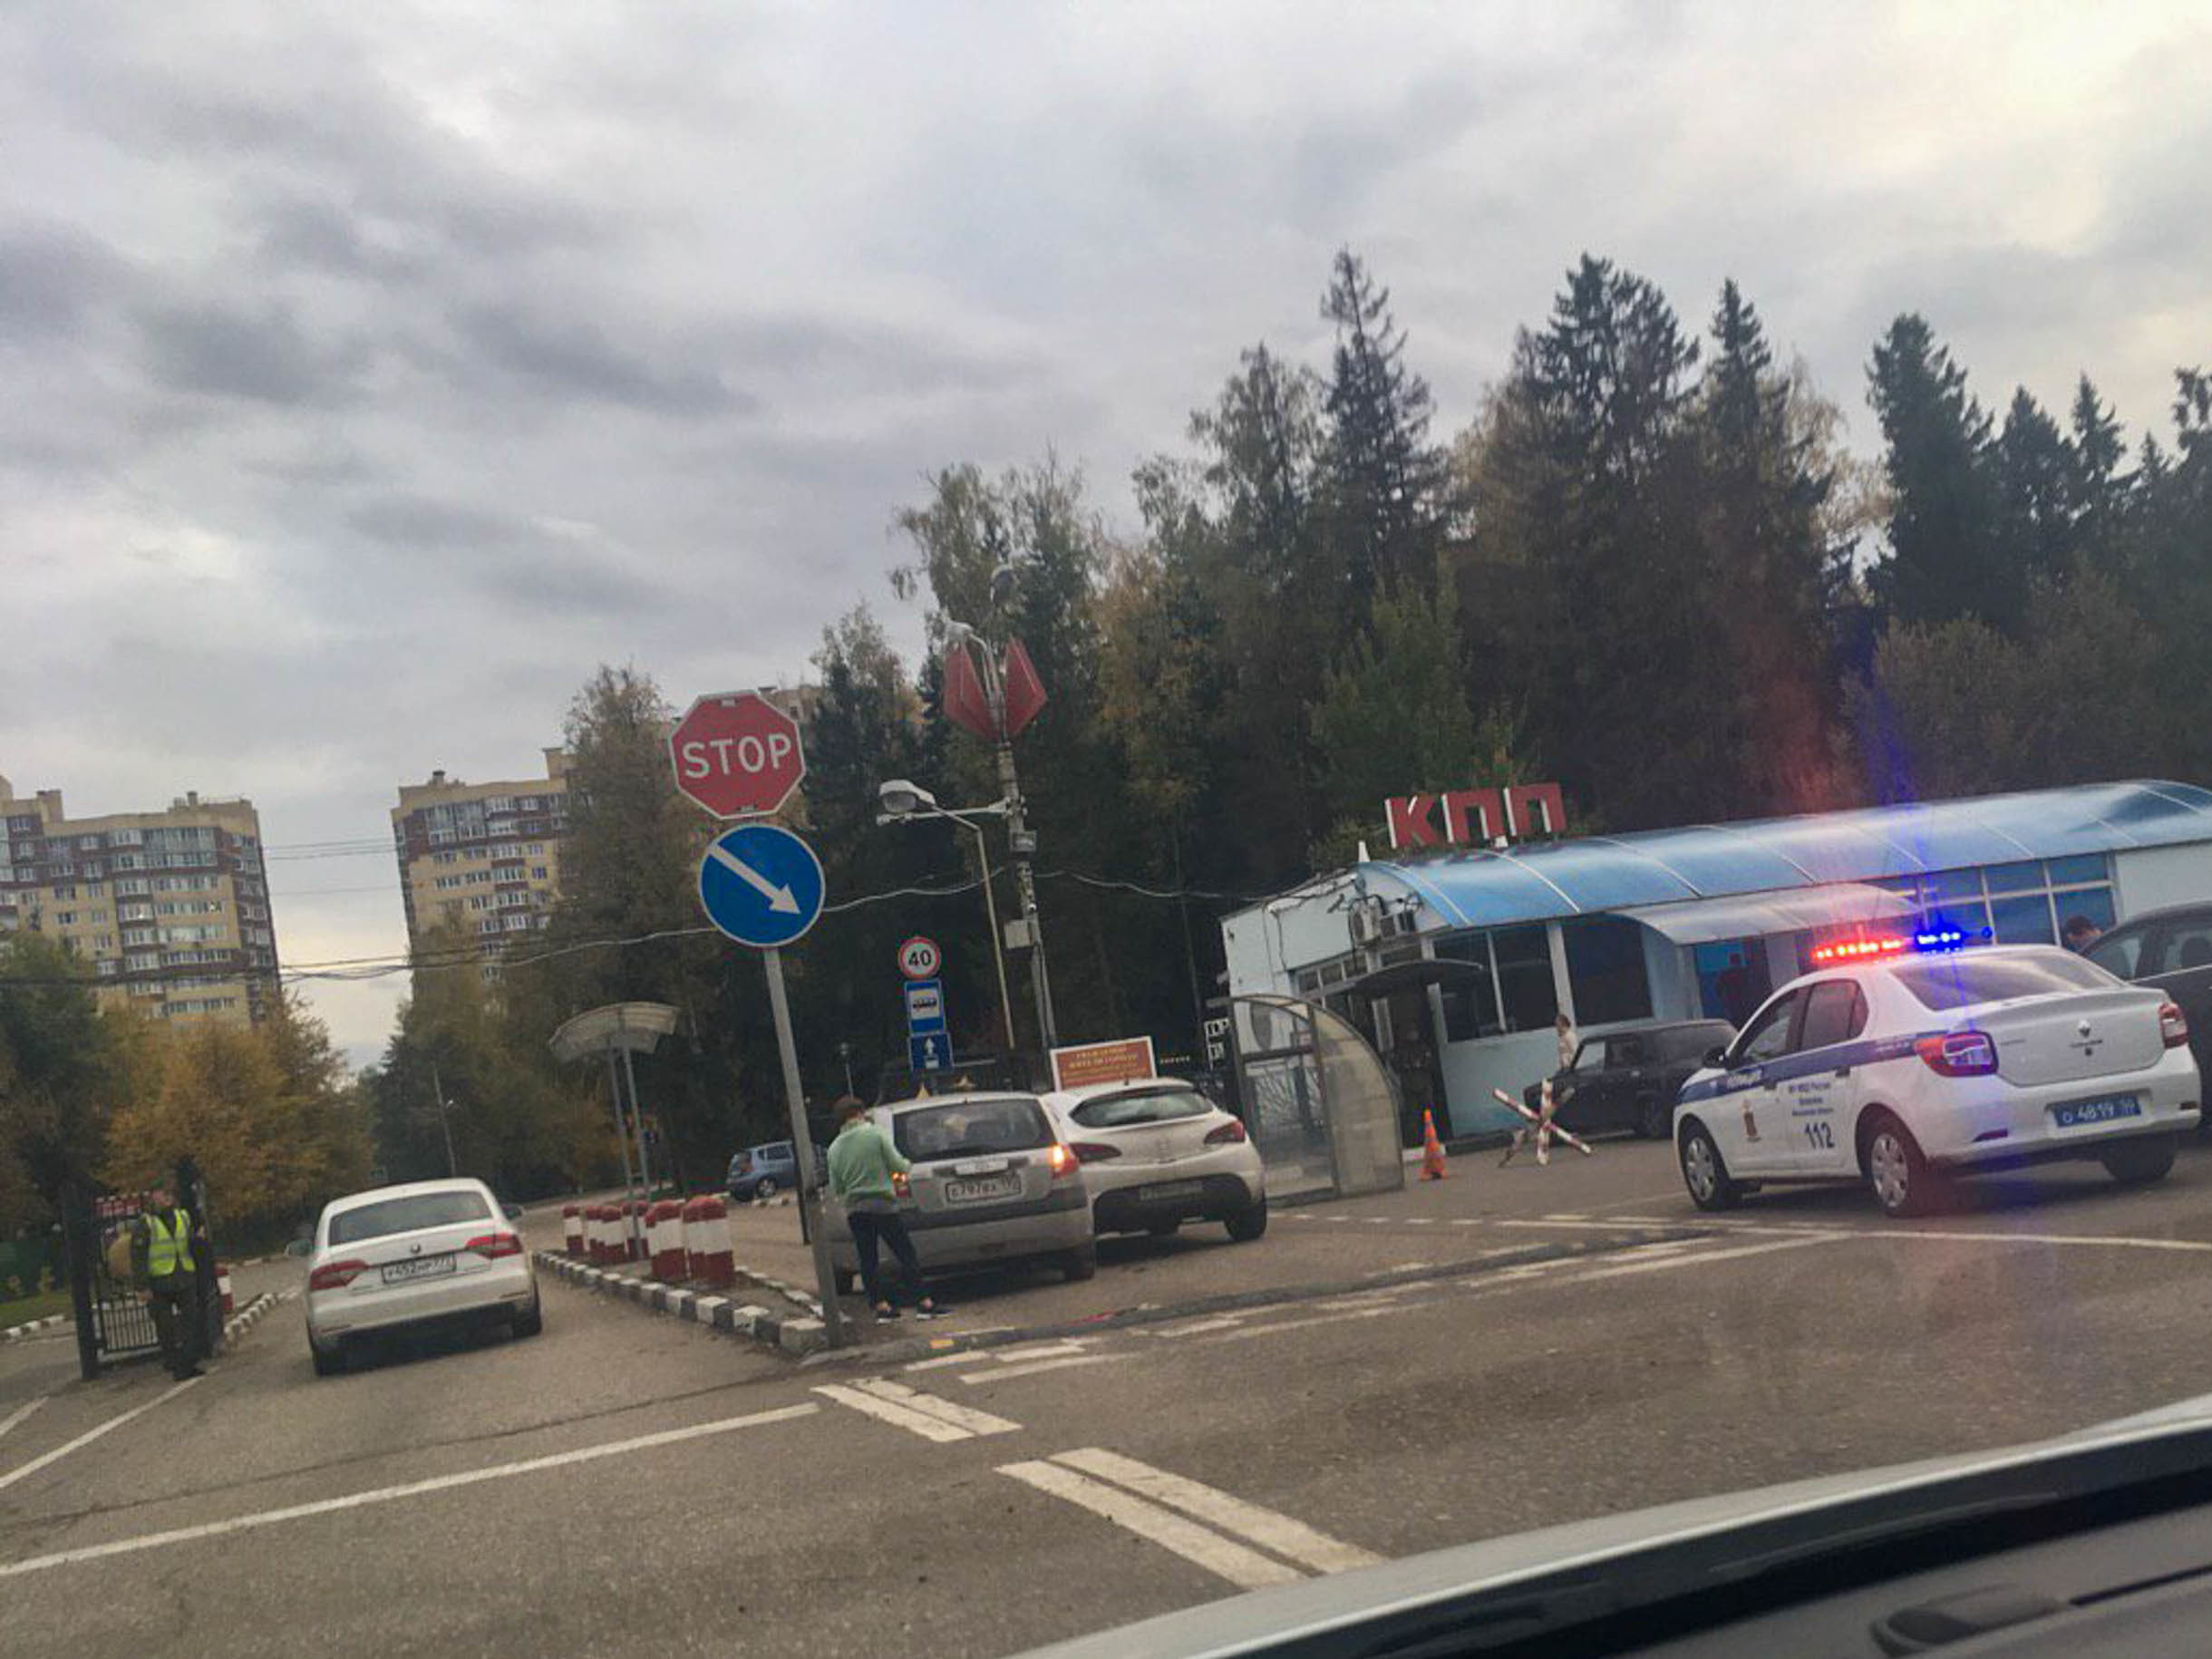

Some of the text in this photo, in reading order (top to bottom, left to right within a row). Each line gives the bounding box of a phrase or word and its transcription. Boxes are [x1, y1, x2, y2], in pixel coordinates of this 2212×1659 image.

[682, 732, 791, 779] STOP
[1384, 782, 1567, 849] КПП
[908, 949, 932, 966] 40
[1804, 1122, 1836, 1150] 112
